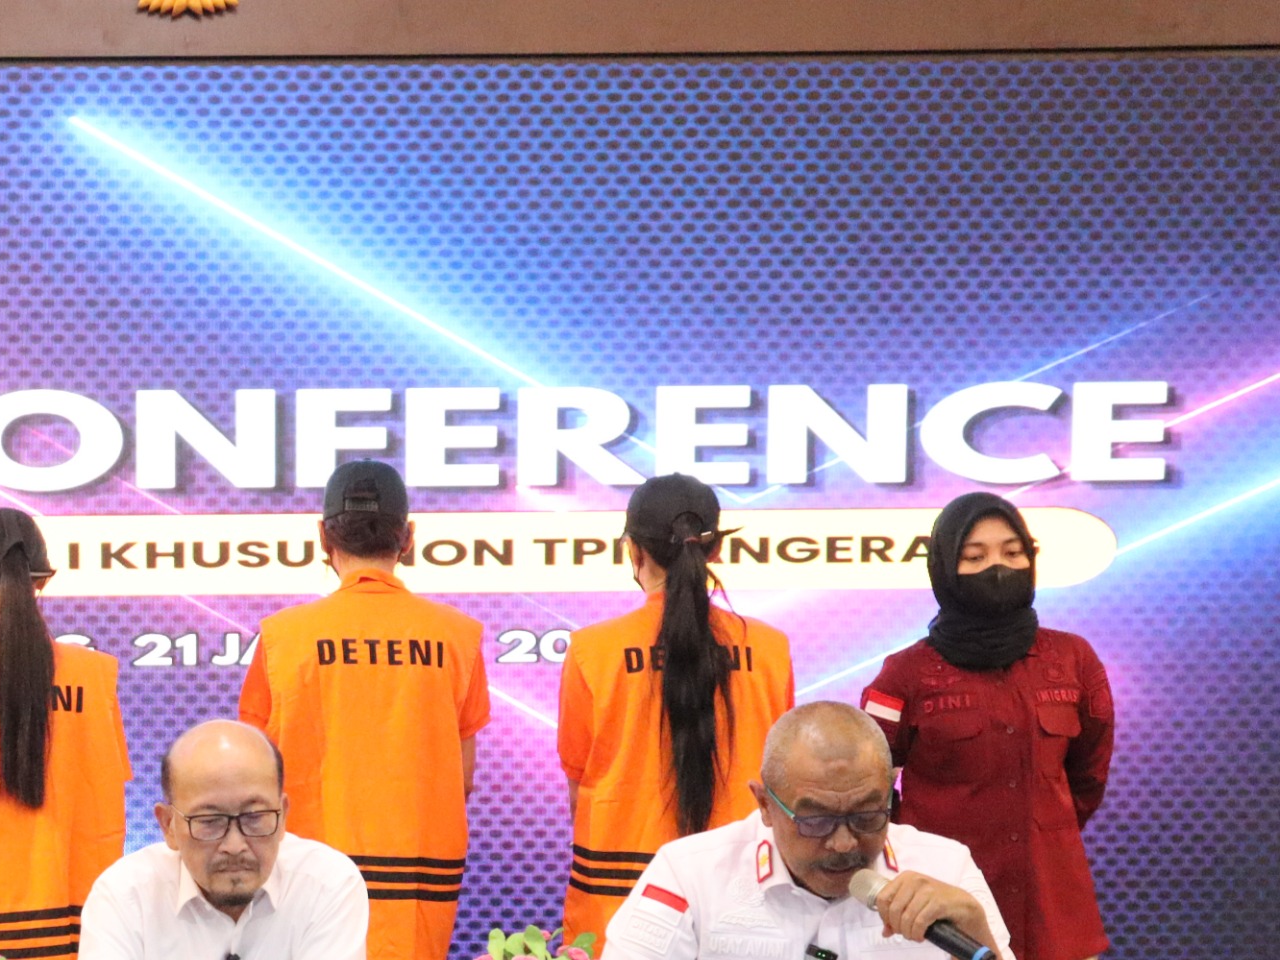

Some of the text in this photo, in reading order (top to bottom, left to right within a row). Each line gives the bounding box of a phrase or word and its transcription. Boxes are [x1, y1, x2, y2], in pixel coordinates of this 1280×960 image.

[68, 543, 80, 569] I
[100, 540, 331, 568] KHUSU
[533, 538, 623, 566] TPI
[713, 535, 1040, 564] NGERA
[132, 632, 198, 666] 21
[317, 638, 444, 668] DETENI
[624, 645, 753, 674] DENI
